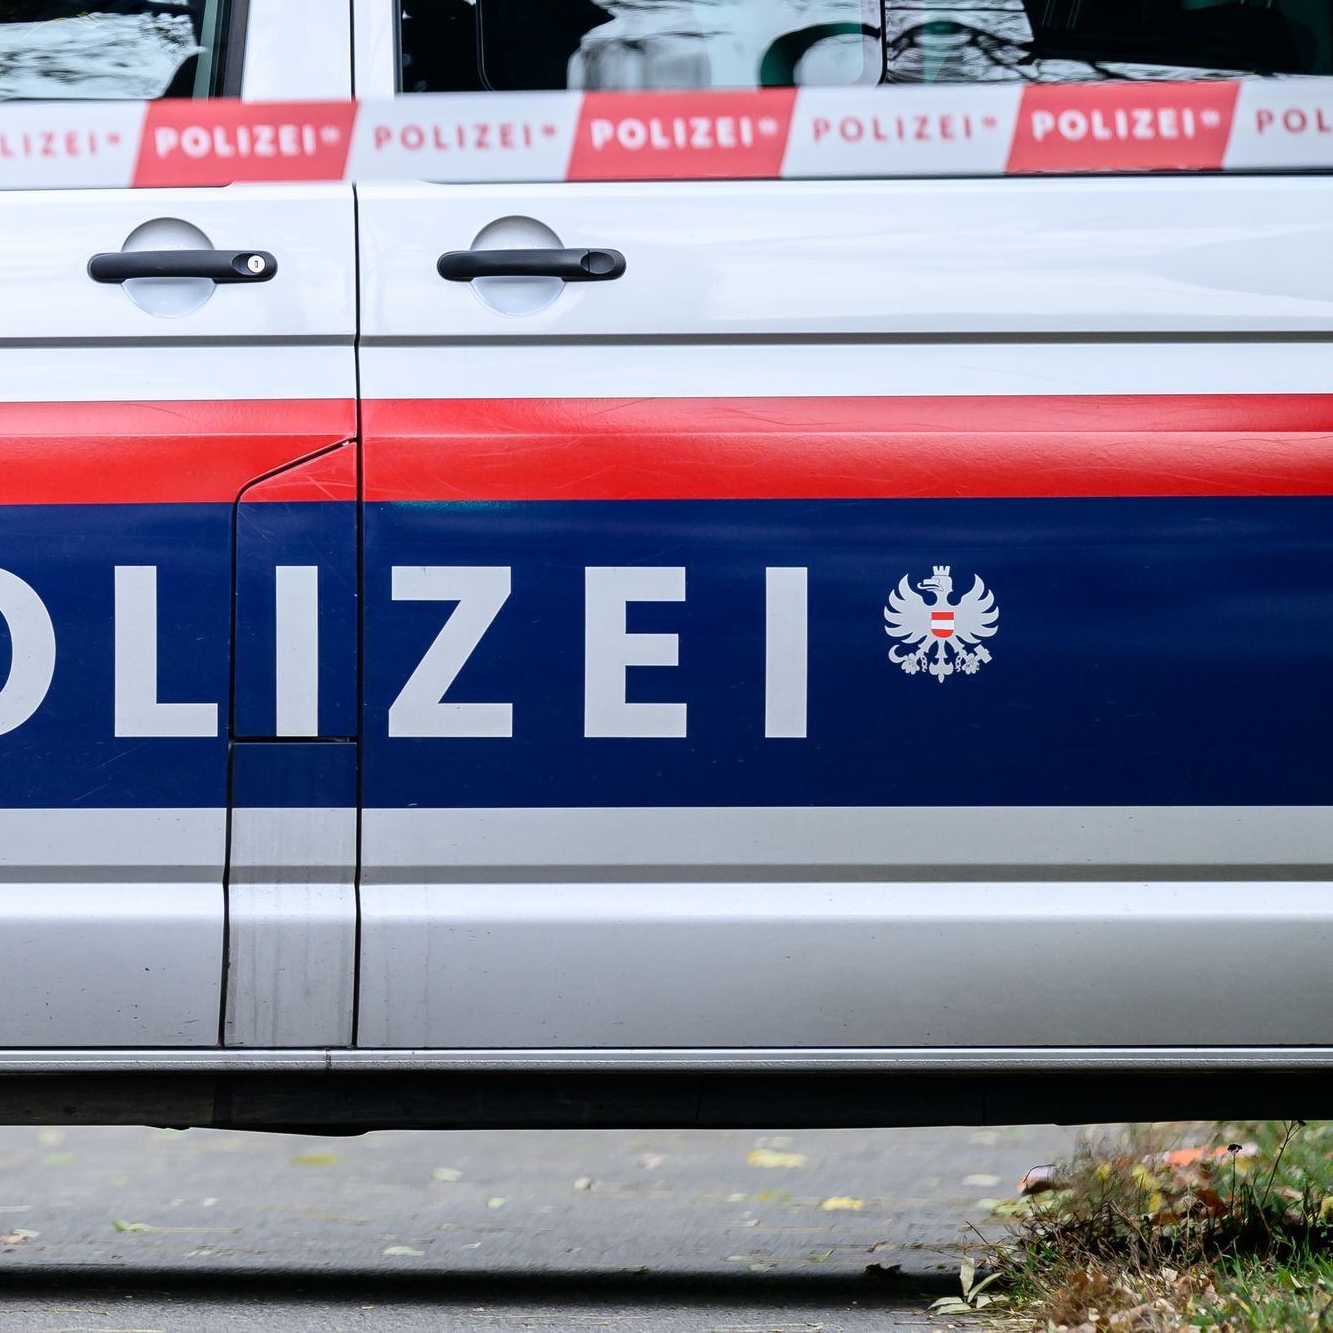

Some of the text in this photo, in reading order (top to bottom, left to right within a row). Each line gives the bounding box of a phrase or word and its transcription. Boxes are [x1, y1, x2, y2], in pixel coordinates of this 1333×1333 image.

[155, 123, 315, 159] POLIZEI
[375, 121, 532, 152] POLIZEI
[590, 116, 753, 150] POLIZEI
[813, 114, 971, 144] POLIZEI
[1033, 107, 1195, 141] POLIZEI
[1255, 108, 1333, 135] POL
